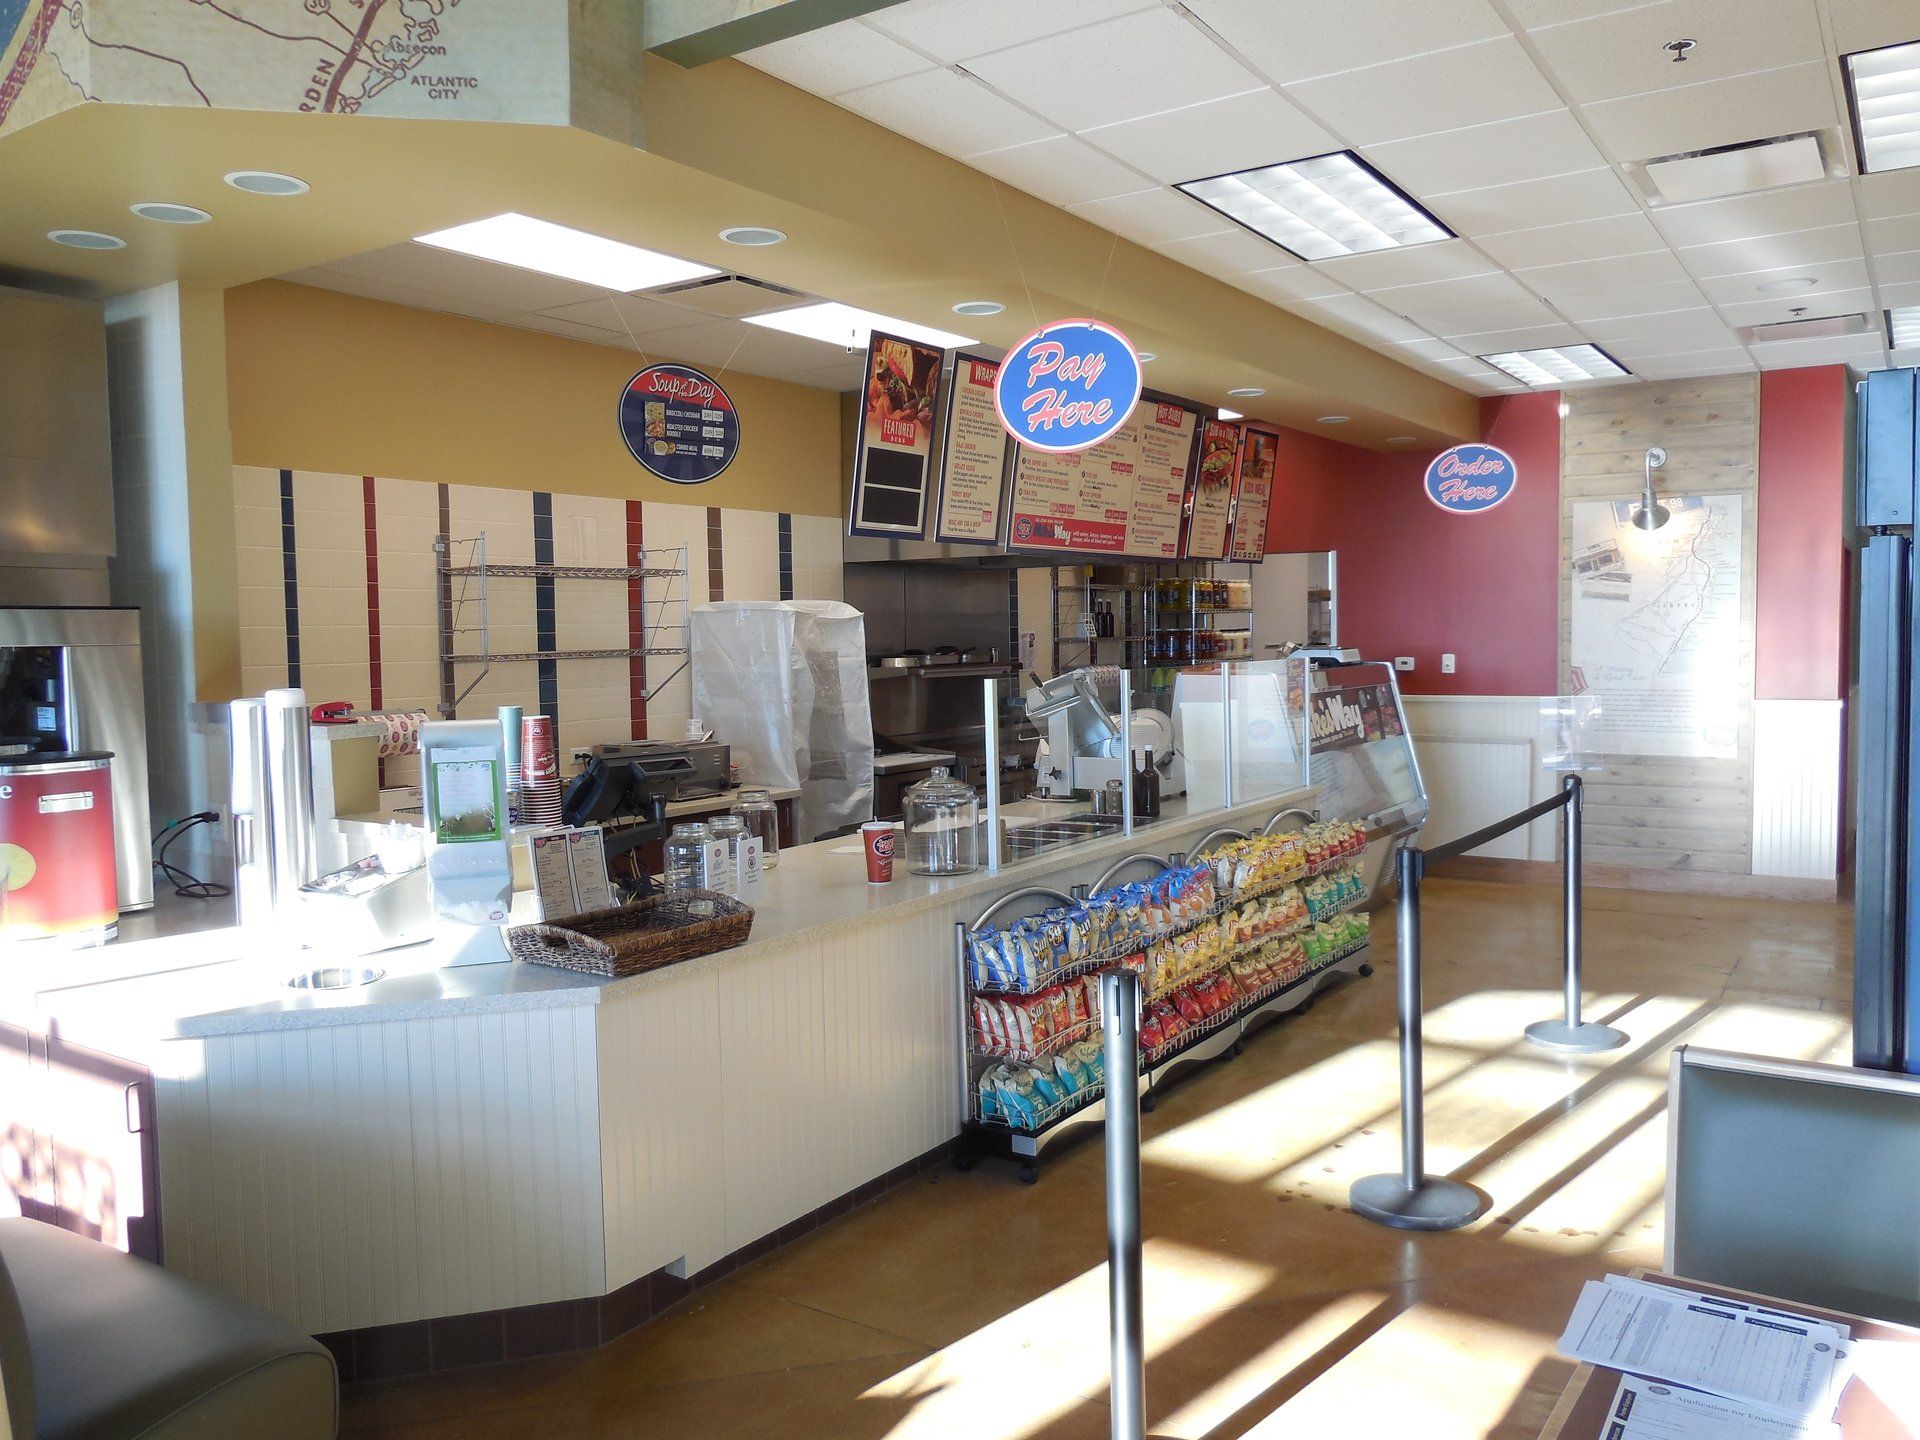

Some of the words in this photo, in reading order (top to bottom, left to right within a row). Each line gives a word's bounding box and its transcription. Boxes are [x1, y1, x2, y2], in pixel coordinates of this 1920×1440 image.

[391, 40, 446, 55] Absecon
[411, 75, 478, 88] ATLANTIC
[428, 88, 460, 99] CITY
[1027, 341, 1107, 390] Pay
[649, 372, 680, 404] Soup
[687, 378, 716, 408] Day
[1022, 387, 1113, 432] Here
[883, 419, 914, 438] FEATURED
[1438, 454, 1504, 477] Order
[1439, 479, 1498, 502] Here
[1669, 497, 1684, 509] 98
[1054, 524, 1071, 545] Way
[1326, 694, 1365, 739] Way
[1078, 918, 1091, 936] un
[1033, 937, 1048, 958] Sun
[1031, 1004, 1045, 1025] Sun
[1678, 1396, 1729, 1413] Application
[1731, 1408, 1744, 1417] for
